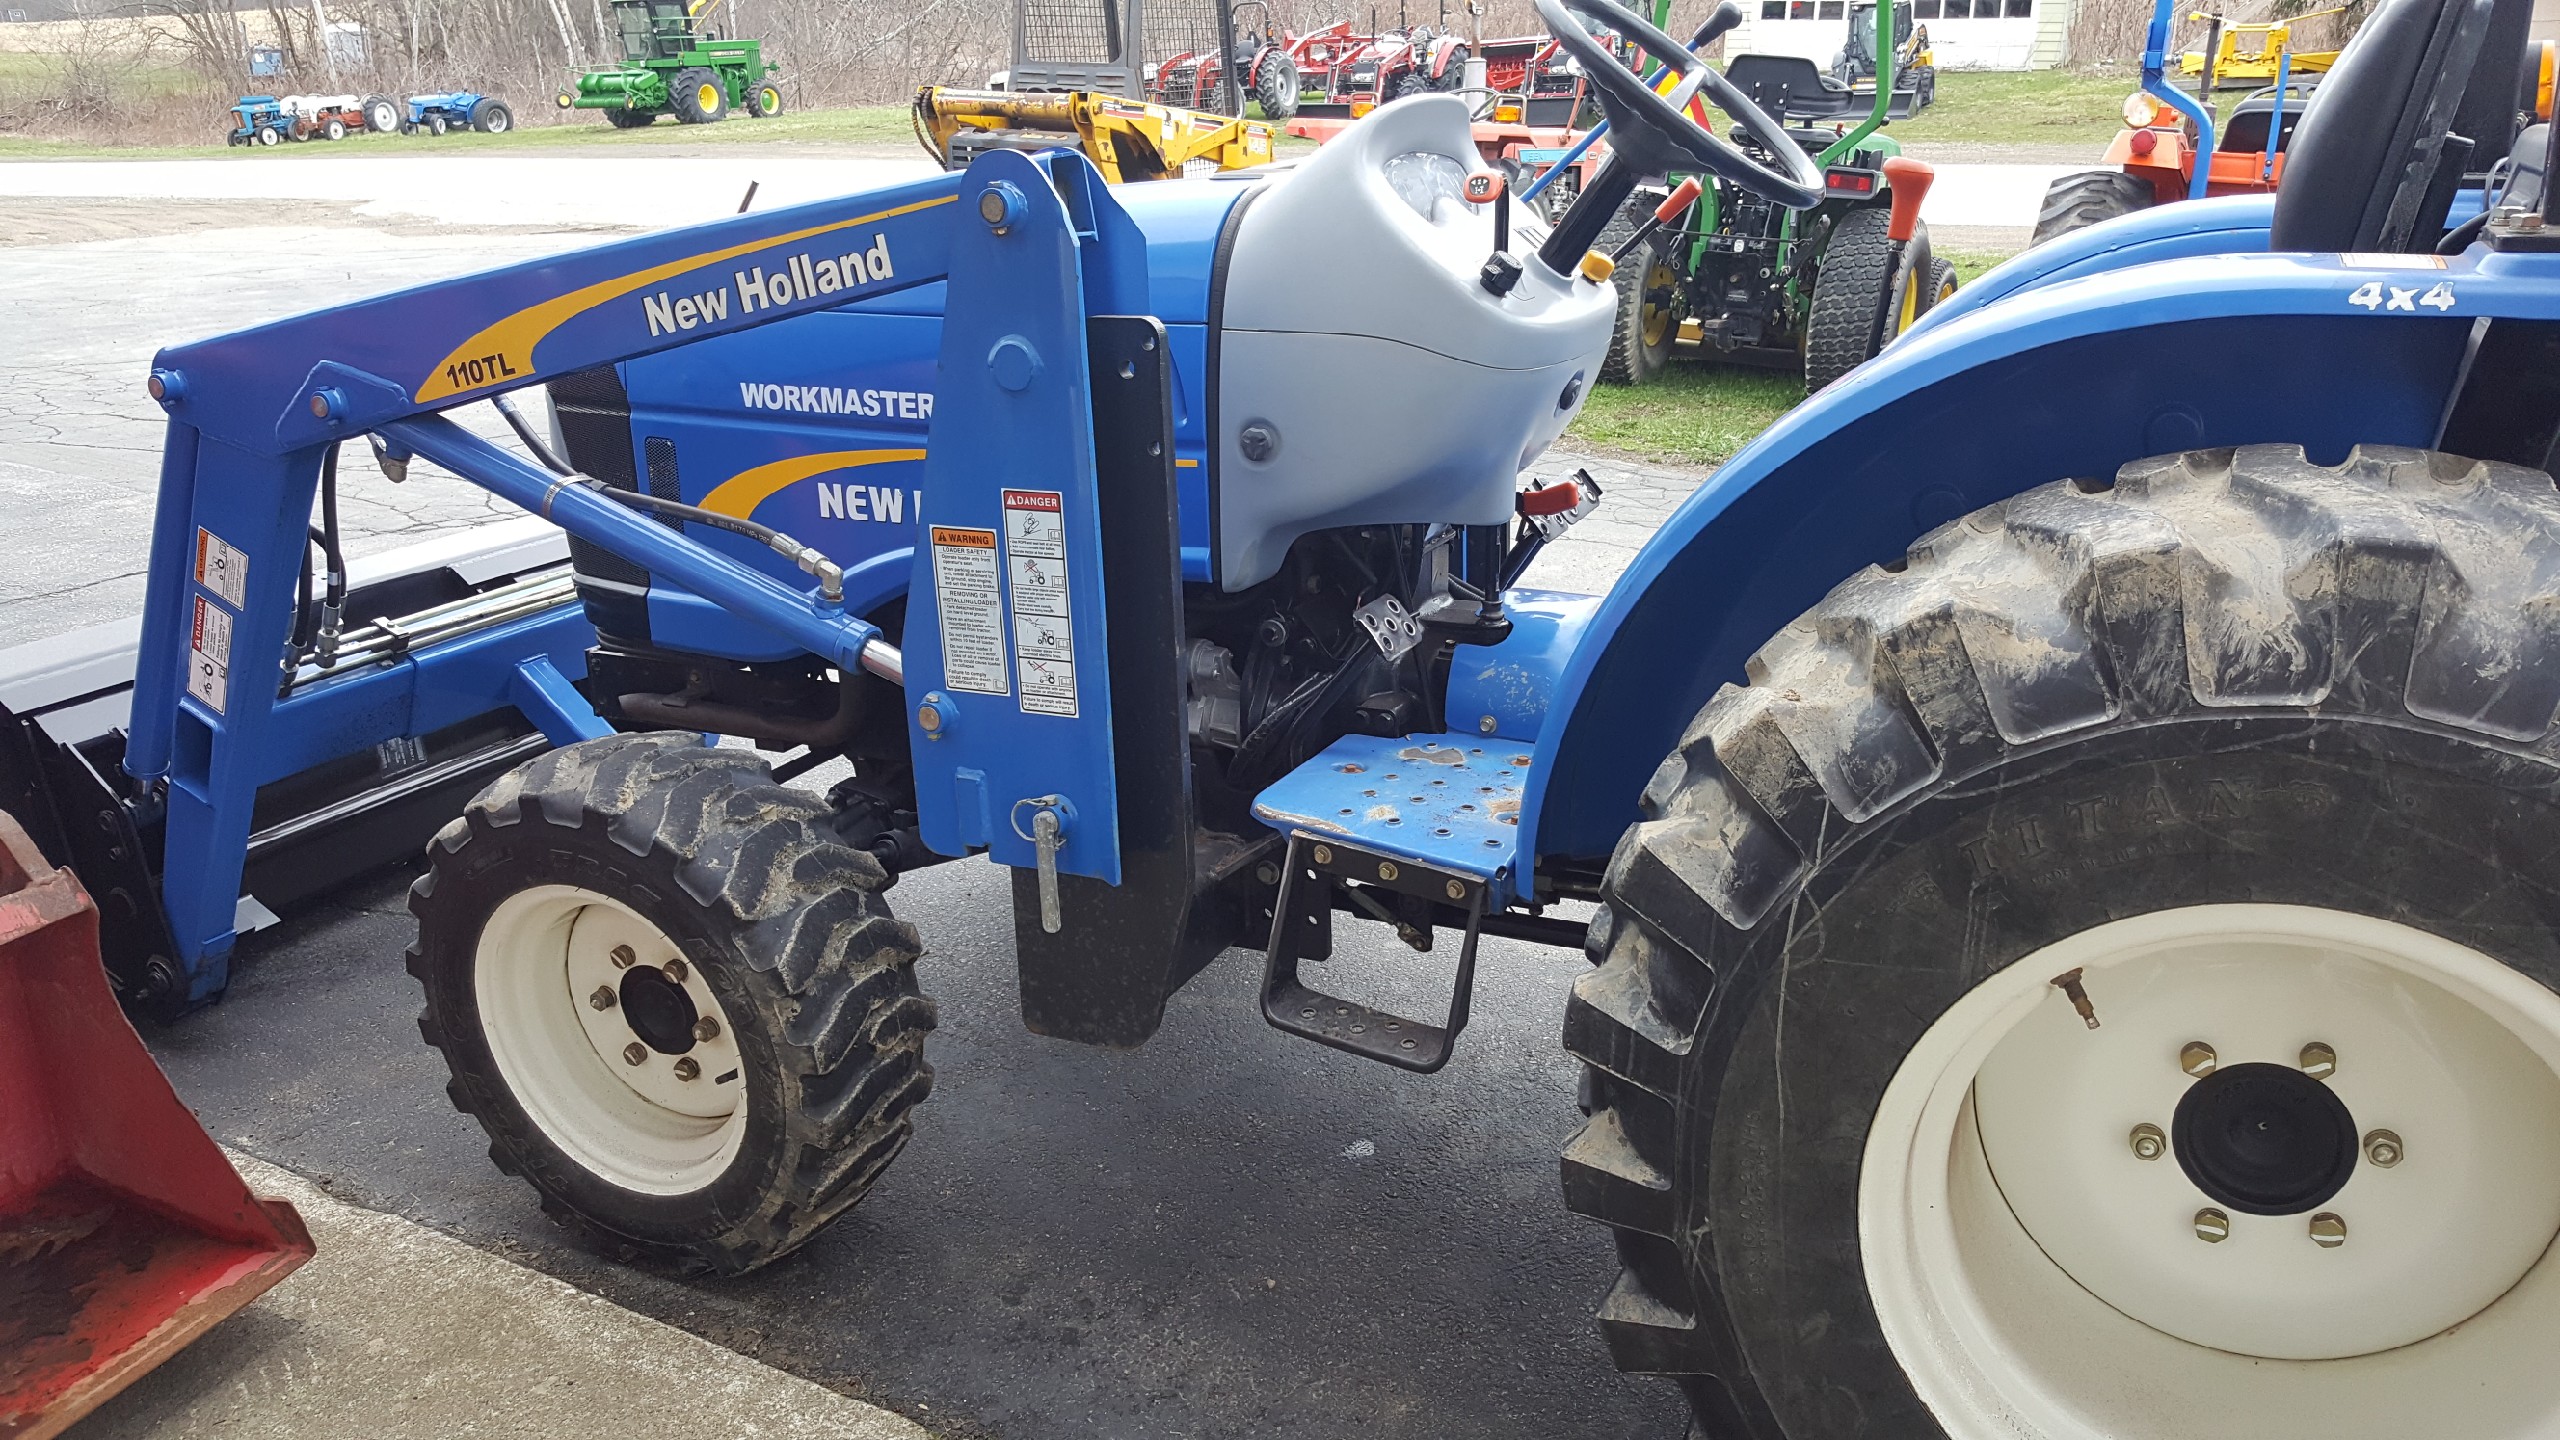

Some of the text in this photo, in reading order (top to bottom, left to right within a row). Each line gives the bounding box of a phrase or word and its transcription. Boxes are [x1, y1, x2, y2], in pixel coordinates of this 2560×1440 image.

[642, 233, 894, 338] New Holland
[2348, 281, 2456, 312] 4x4
[446, 353, 516, 388] 110TL
[740, 382, 934, 419] WORKMASTER
[817, 482, 903, 523] NEW
[1017, 496, 1057, 507] DANGER
[948, 534, 989, 545] WARNING
[950, 590, 978, 598] REMOVING
[196, 600, 204, 637] DANGER
[1959, 777, 2252, 880] TITAN
